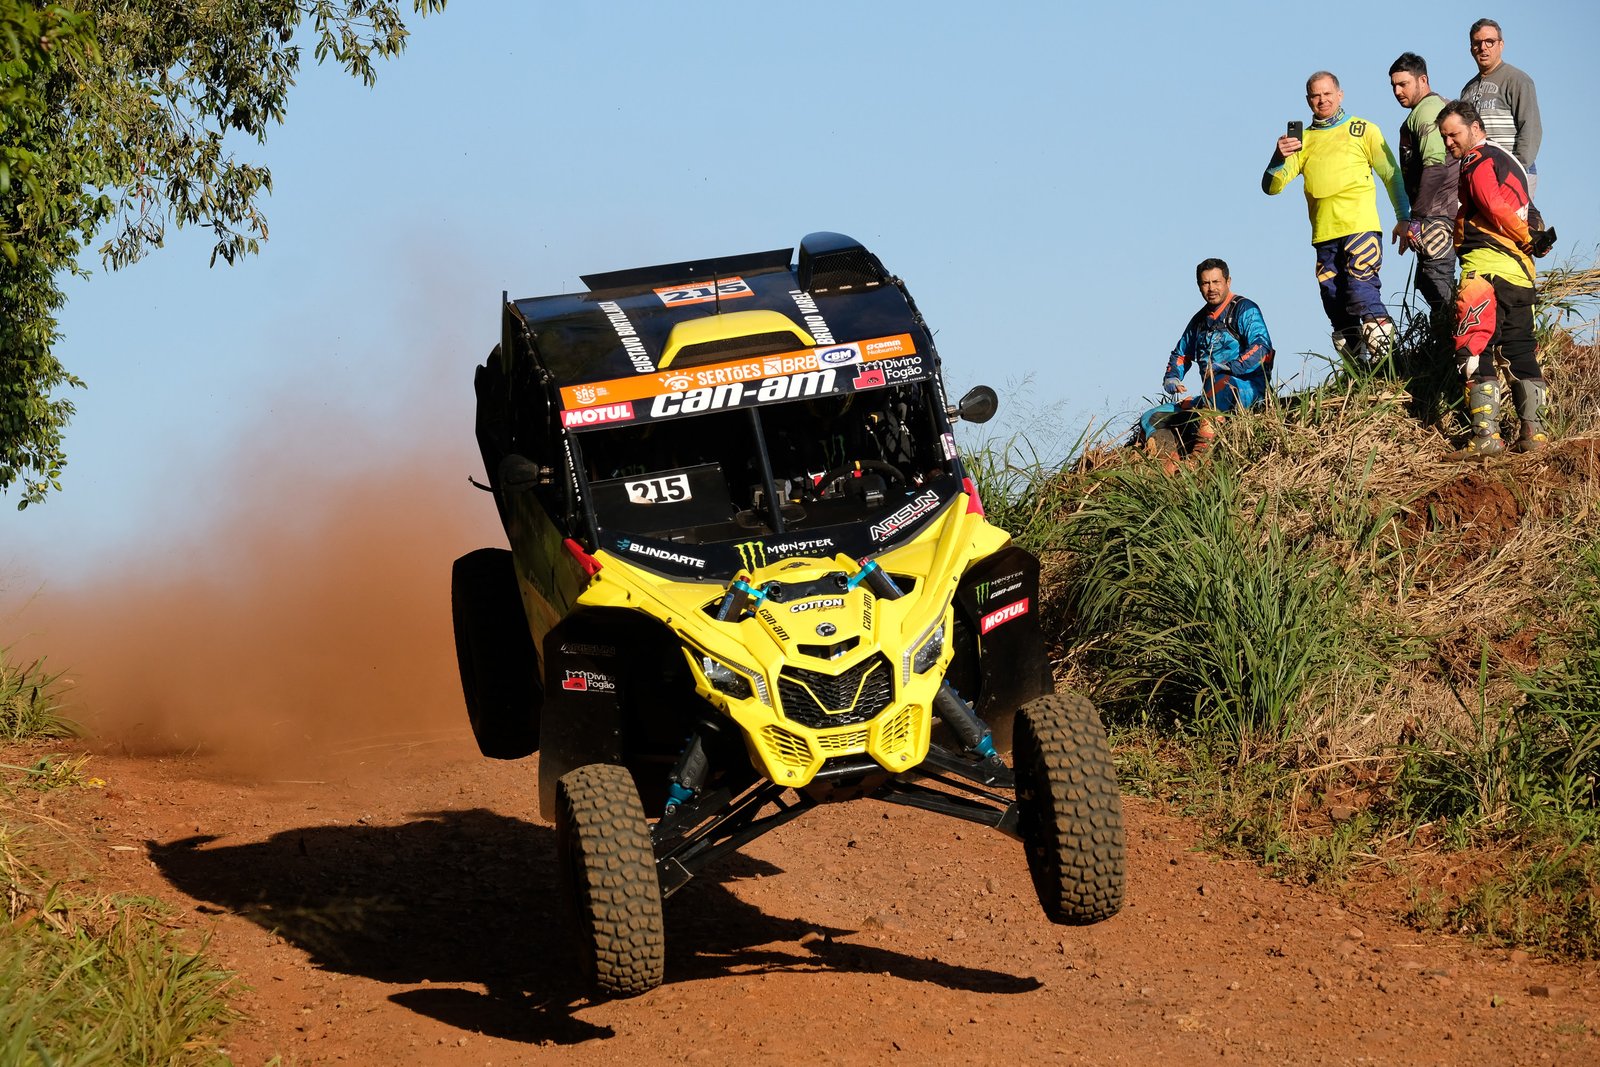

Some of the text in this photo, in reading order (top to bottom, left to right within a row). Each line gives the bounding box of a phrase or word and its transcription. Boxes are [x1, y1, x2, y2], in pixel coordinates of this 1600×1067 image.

[664, 282, 747, 302] 215
[804, 315, 836, 345] BRUNO
[620, 336, 656, 373] GUSTAVO
[783, 355, 818, 373] BRB
[824, 349, 852, 361] CBM
[883, 356, 922, 370] Divino
[885, 366, 923, 379] Fogão
[650, 368, 837, 418] can-am
[565, 405, 631, 426] MOTUL
[631, 477, 685, 503] 215
[869, 489, 940, 541] ARISUN
[629, 542, 706, 569] BLINDARTE
[767, 538, 834, 554] MONSTER
[779, 548, 825, 559] ENERGY
[790, 598, 844, 613] COTTON
[862, 593, 872, 631] can-am
[758, 608, 791, 642] can-am
[984, 602, 1025, 631] MOTUL
[588, 680, 616, 690] Fogão
